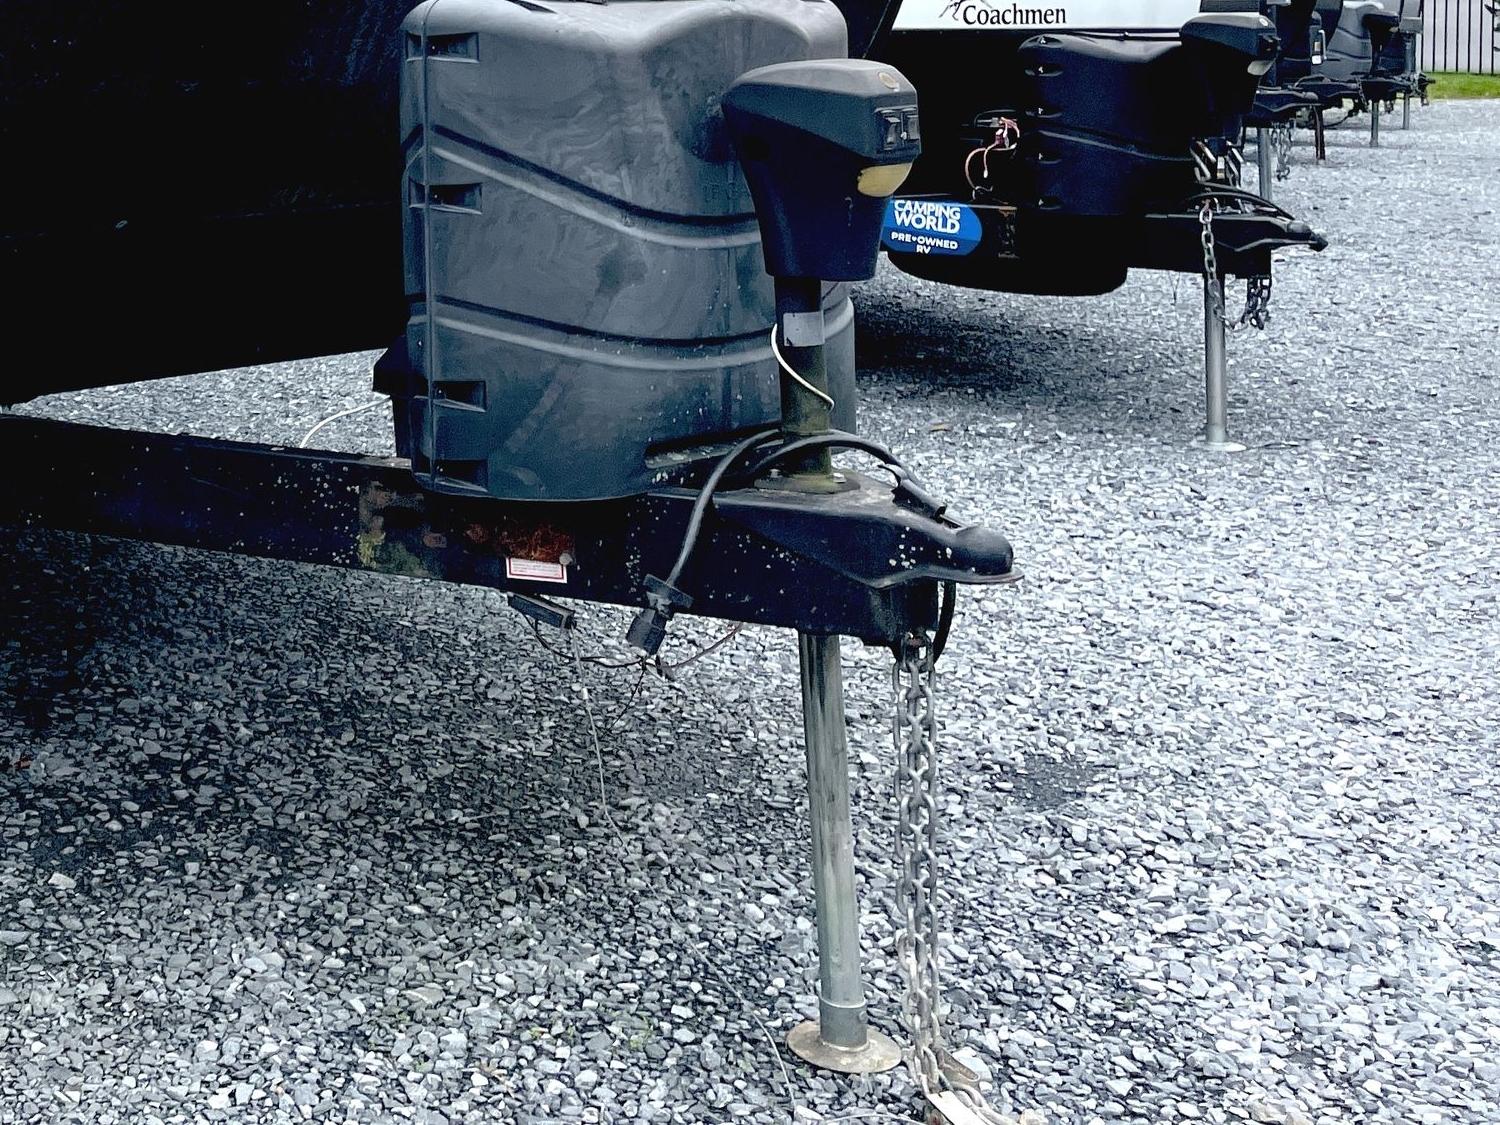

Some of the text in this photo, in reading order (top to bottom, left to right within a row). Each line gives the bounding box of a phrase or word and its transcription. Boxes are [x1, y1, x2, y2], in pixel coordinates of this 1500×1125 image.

[962, 2, 1067, 26] Coachmen
[893, 199, 961, 221] CAMPING
[893, 210, 960, 234] WORLD
[916, 244, 932, 255] RV
